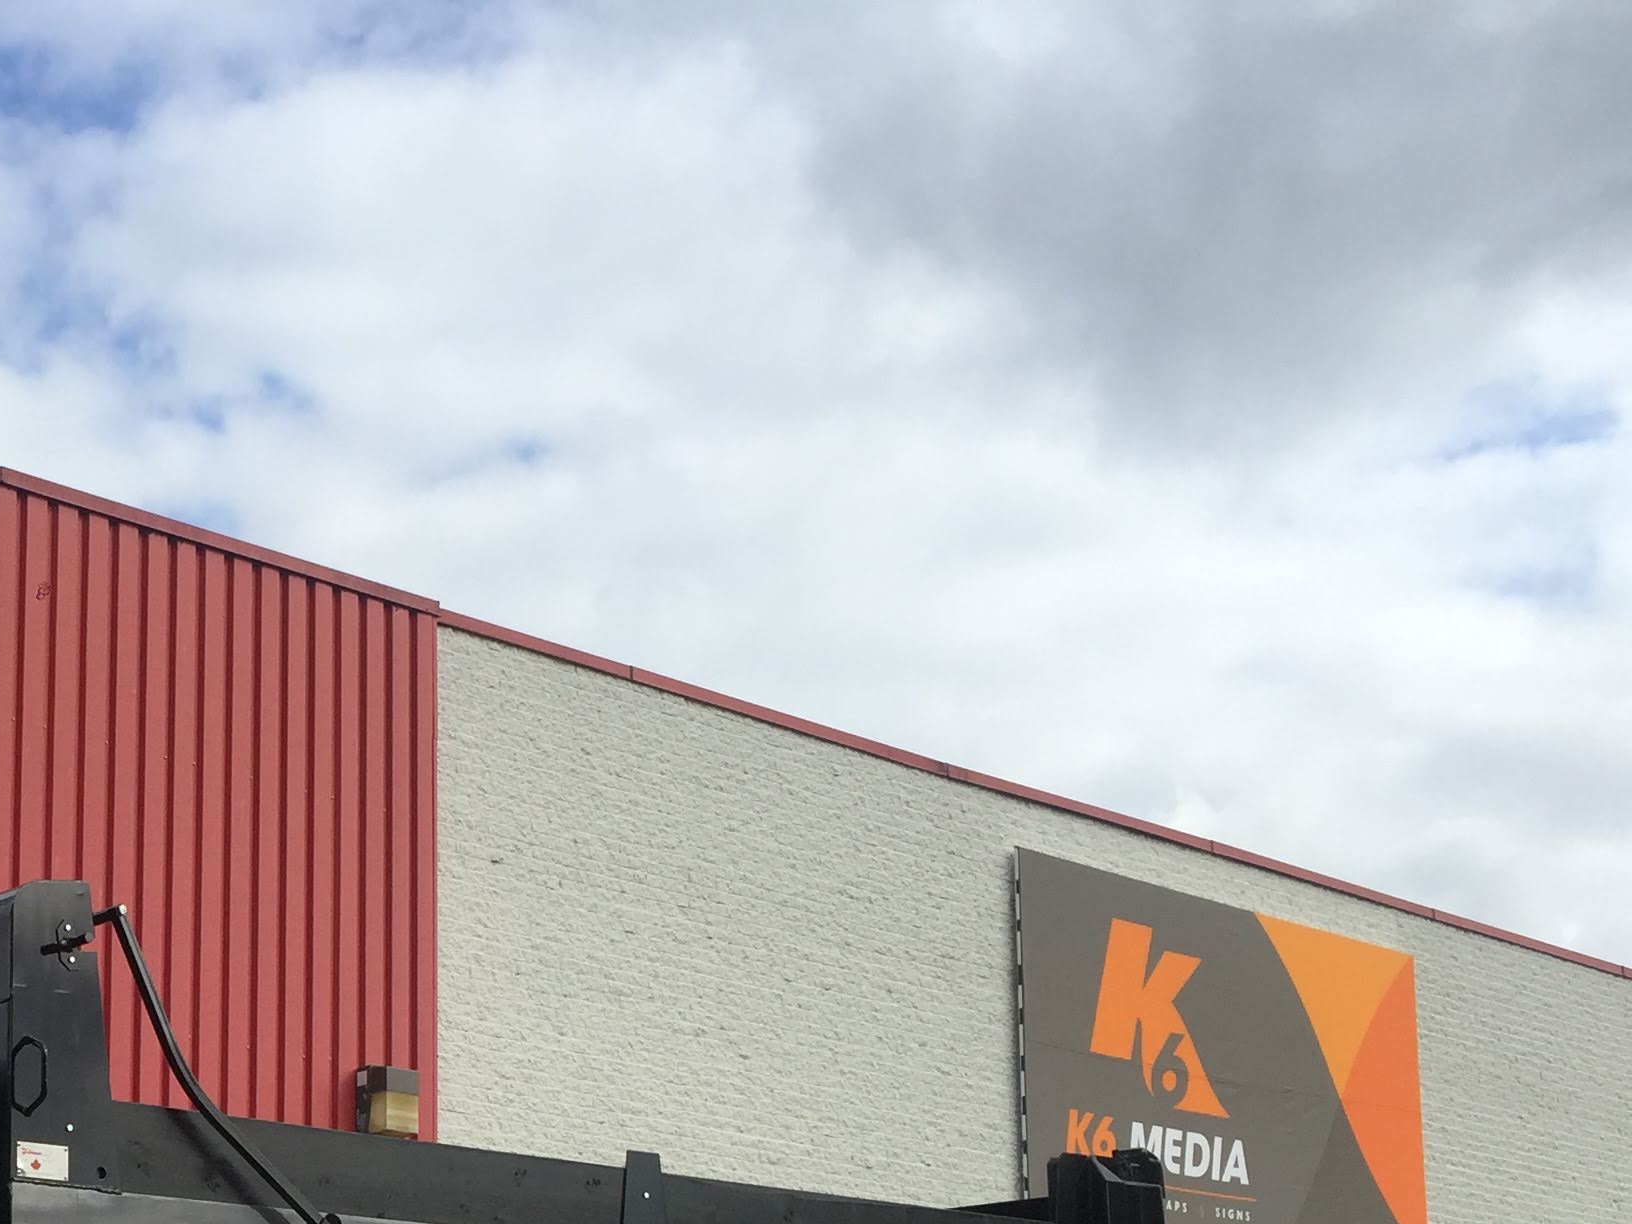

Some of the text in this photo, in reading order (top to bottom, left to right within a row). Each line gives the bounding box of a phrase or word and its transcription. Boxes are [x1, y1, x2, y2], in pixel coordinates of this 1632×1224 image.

[1067, 1109, 1250, 1185] K6 MEDIA
[1166, 1199, 1251, 1222] APS SIGNS
